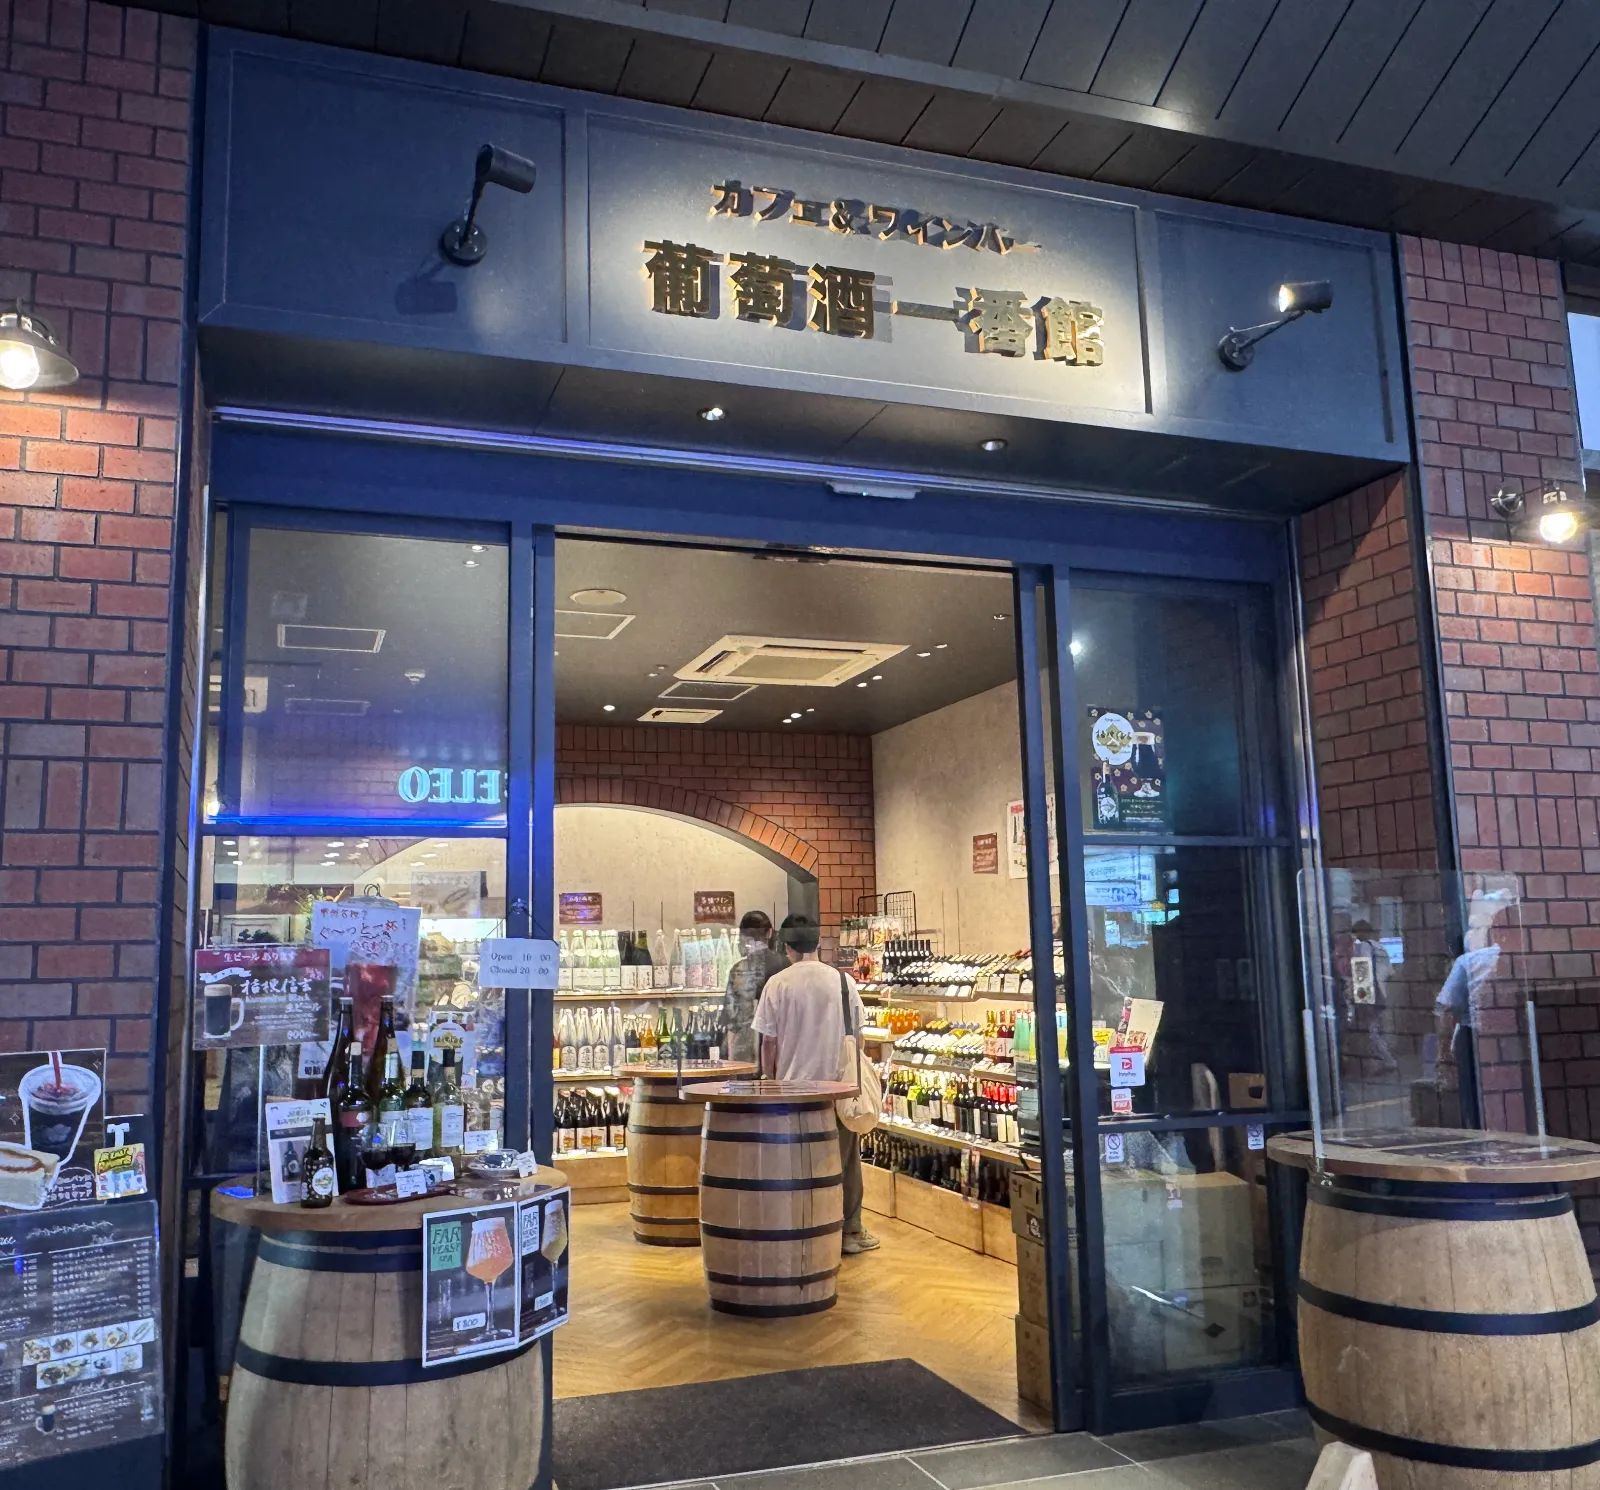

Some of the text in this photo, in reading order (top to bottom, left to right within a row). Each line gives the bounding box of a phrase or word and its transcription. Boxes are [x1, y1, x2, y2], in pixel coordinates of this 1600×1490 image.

[641, 239, 1106, 367] 葡萄酒一番館
[491, 952, 513, 962] Open
[433, 1227, 463, 1244] FAR
